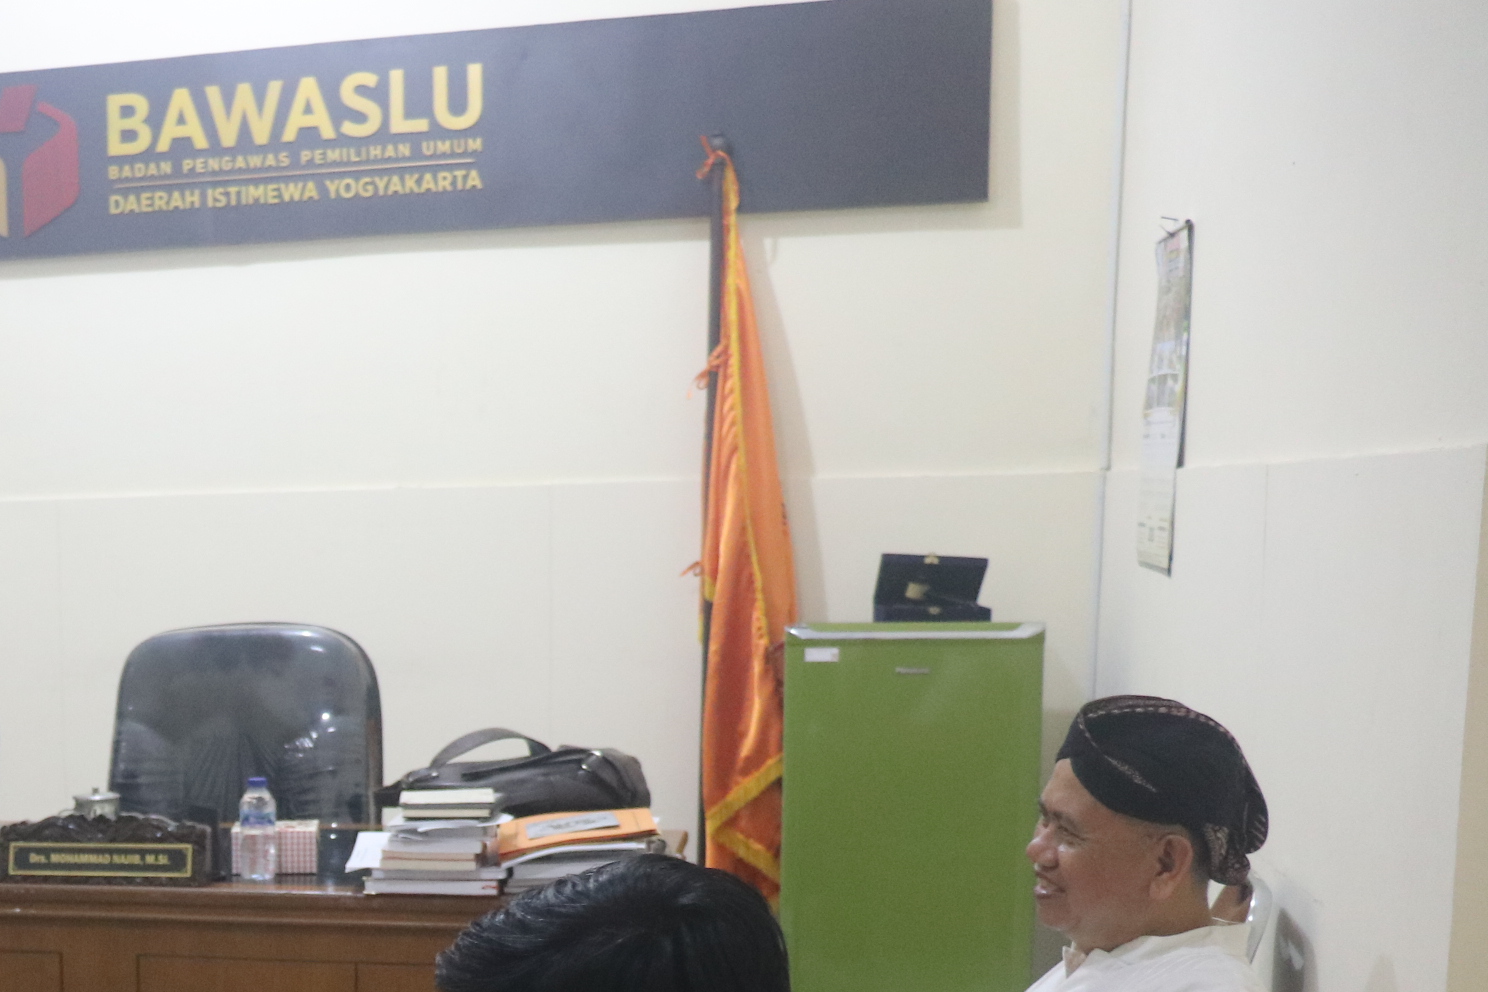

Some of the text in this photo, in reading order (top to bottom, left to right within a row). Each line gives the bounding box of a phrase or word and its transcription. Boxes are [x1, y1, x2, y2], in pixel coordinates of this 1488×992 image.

[106, 62, 484, 157] BAWASLU
[108, 137, 484, 180] BADAN PENGAWAS PEMILIHAN UMUM
[109, 169, 483, 215] DAERAH ISTIMEWA YOGYAKARTA
